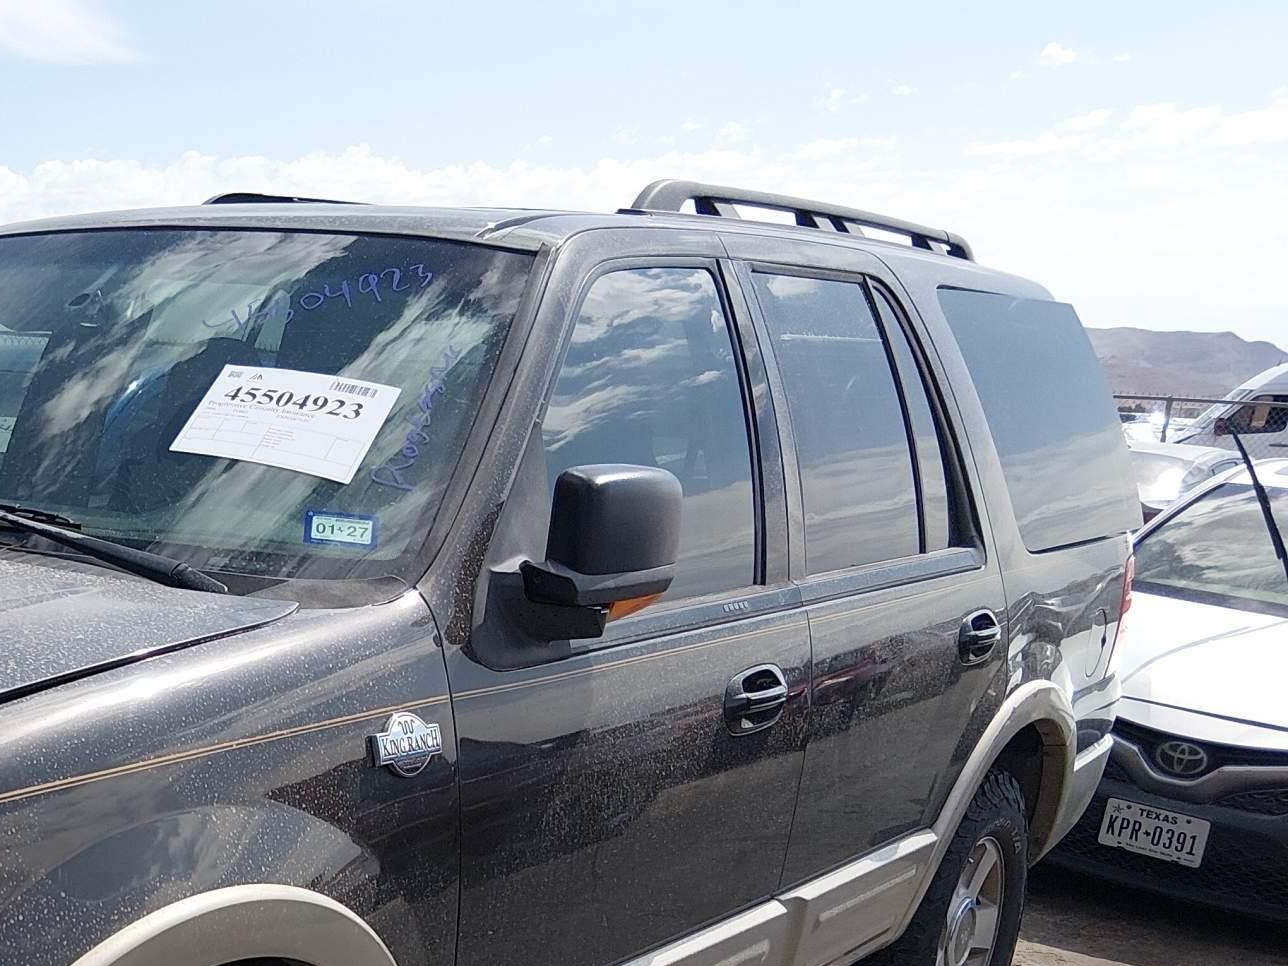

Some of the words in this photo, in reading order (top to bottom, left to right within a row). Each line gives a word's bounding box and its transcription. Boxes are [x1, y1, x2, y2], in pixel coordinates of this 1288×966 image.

[224, 385, 364, 420] 45504923
[316, 522, 335, 535] 01
[346, 526, 369, 539] 27
[381, 737, 407, 757] KING
[407, 729, 440, 752] RANCH
[1138, 807, 1179, 825] TEXAS
[1106, 814, 1143, 842] KPR
[1150, 825, 1197, 857] 0391
